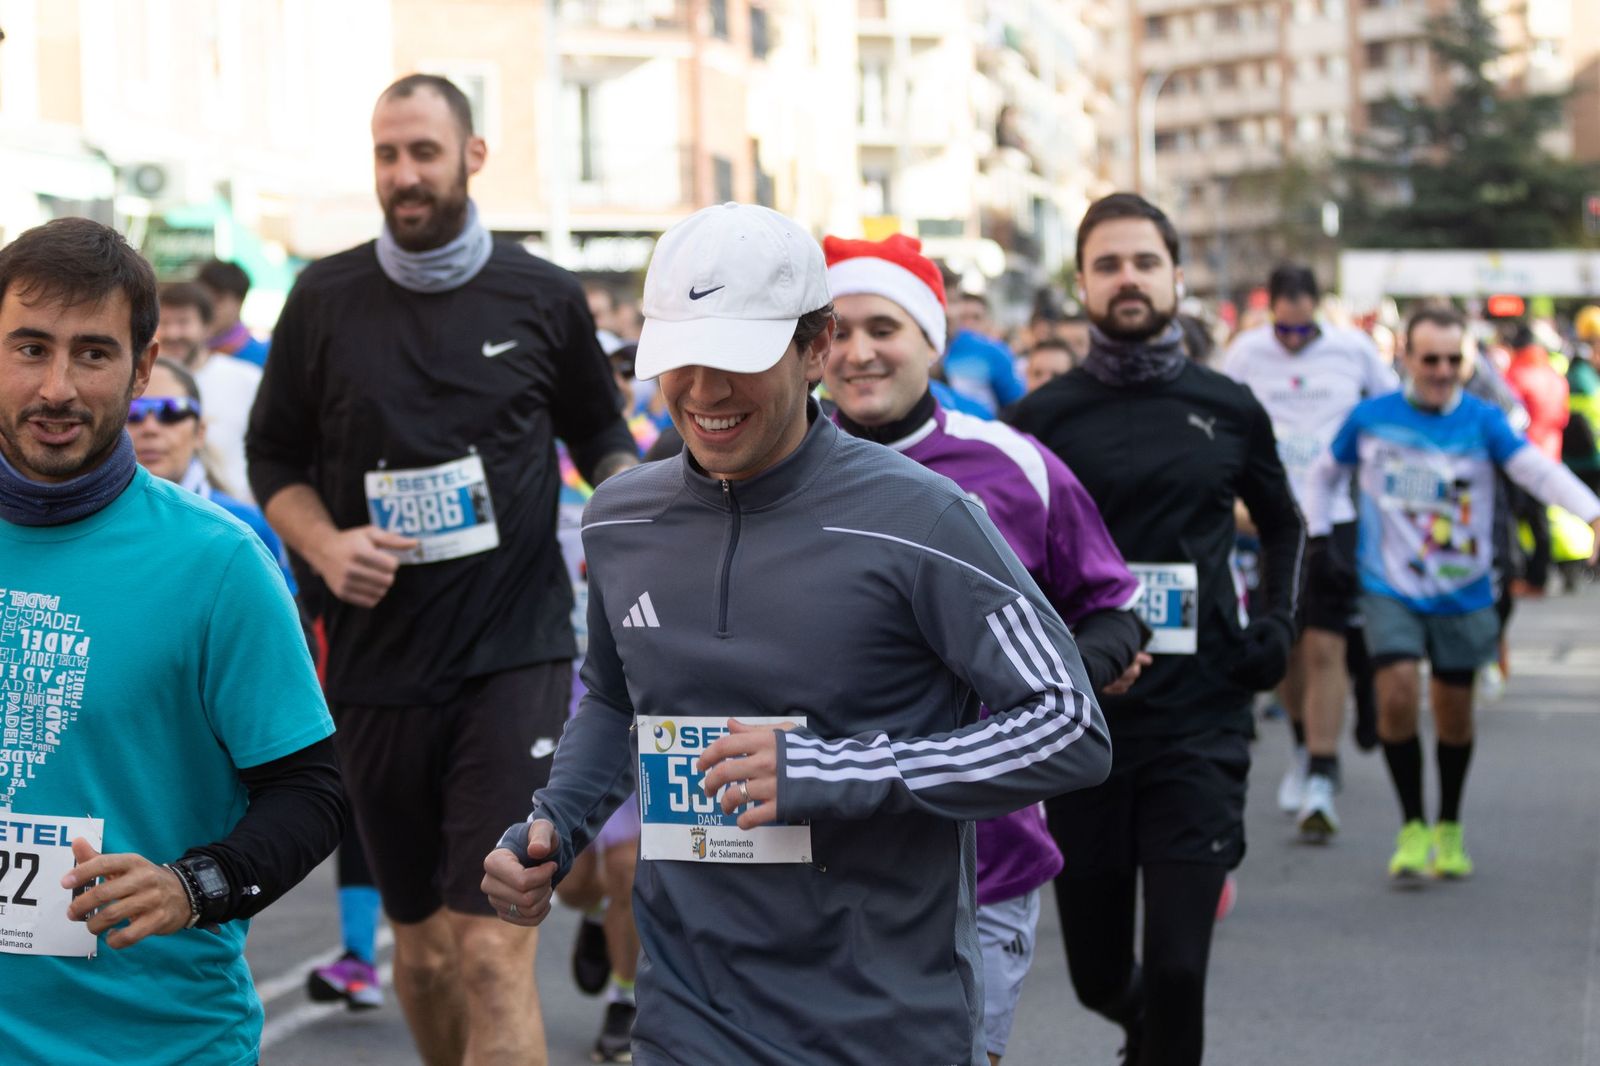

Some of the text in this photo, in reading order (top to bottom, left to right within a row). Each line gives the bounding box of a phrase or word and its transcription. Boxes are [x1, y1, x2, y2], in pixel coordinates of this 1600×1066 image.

[396, 469, 470, 491] SETEL
[382, 490, 464, 533] 2986
[9, 591, 60, 611] PADEL
[32, 610, 84, 633] PADEL
[20, 629, 90, 656] PADEL
[23, 650, 56, 669] PADEL
[71, 668, 88, 709] PADEL
[3, 691, 21, 748] PADEL
[19, 704, 35, 749] PADEL
[35, 706, 44, 742] PADEL
[45, 688, 64, 745] PADEL
[680, 726, 729, 748] SE
[32, 743, 56, 754] PADEL
[667, 756, 755, 813] 53
[697, 814, 723, 826] DANI
[709, 838, 754, 848] Ayuntamiento
[709, 850, 754, 859] de Salamanca
[0, 928, 33, 938] tamiento
